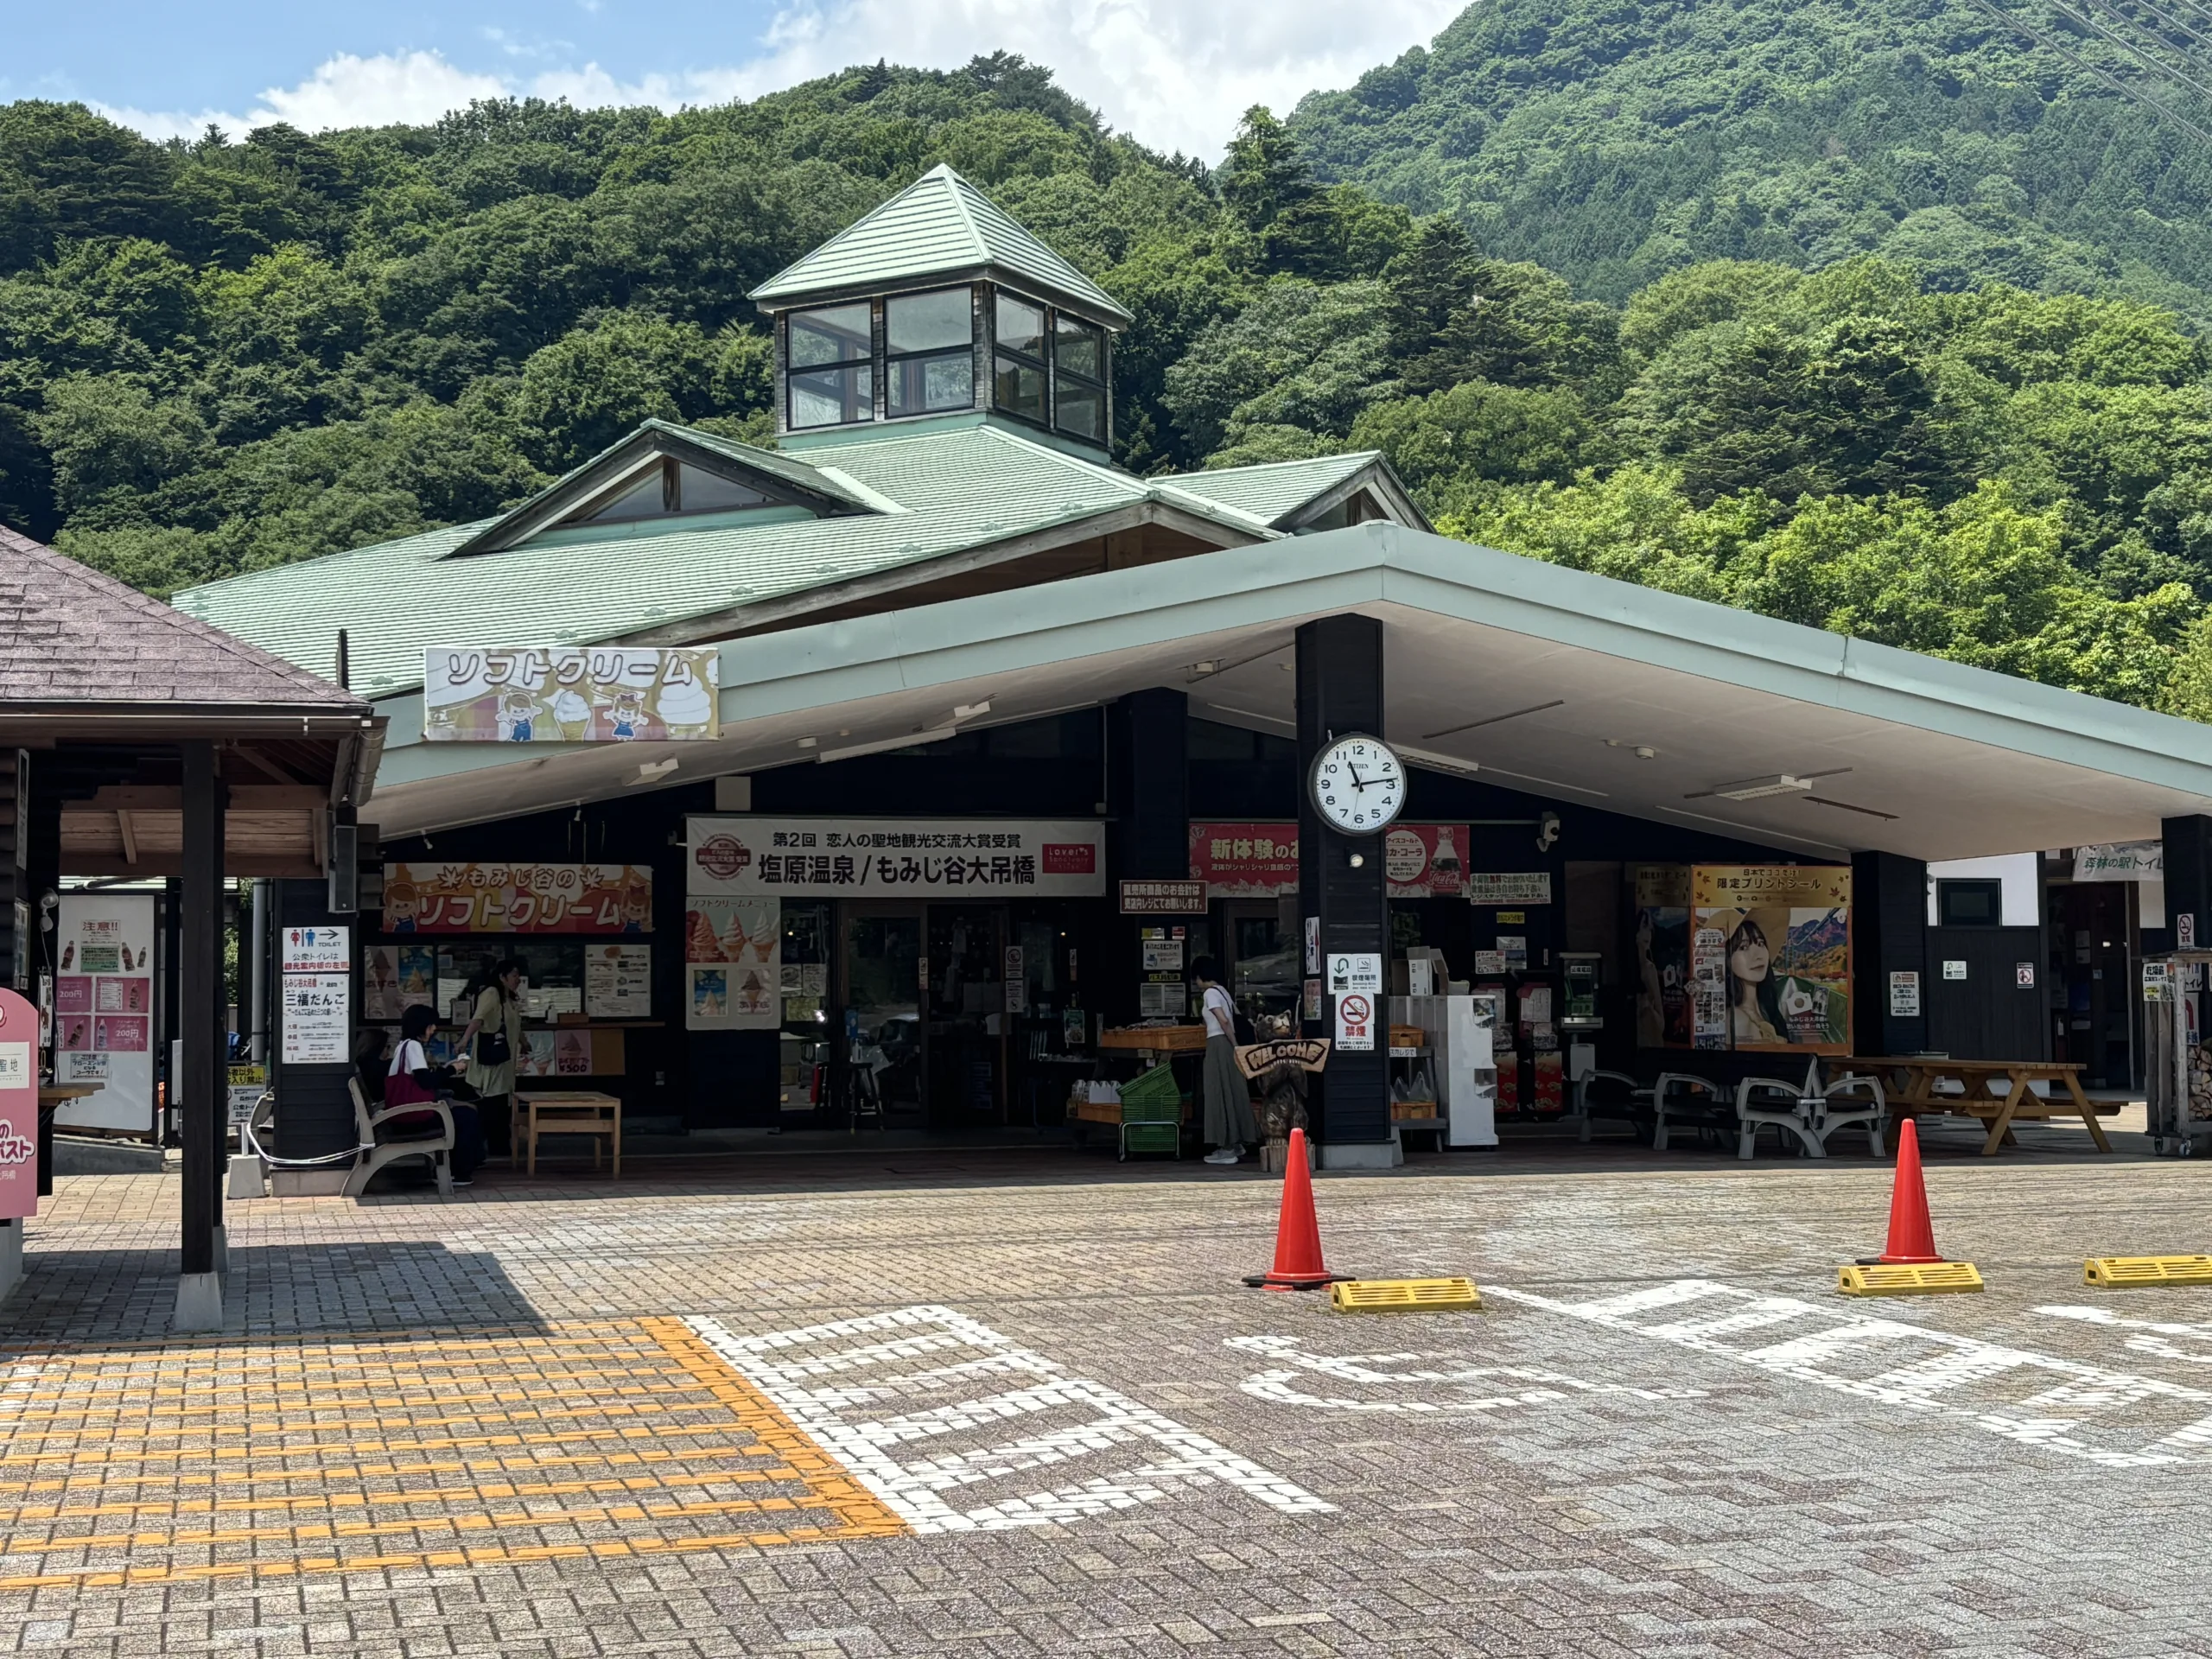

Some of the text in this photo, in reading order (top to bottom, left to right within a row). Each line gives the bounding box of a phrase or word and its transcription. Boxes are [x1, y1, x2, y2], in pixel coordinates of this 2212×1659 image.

[448, 652, 693, 686] ソフトクリーム
[1352, 745, 1365, 755] 12
[1374, 750, 1377, 760] 1
[1336, 751, 1347, 760] 11
[1325, 764, 1338, 774] 10
[1382, 762, 1392, 772] 2
[1320, 779, 1331, 790] 9
[1385, 779, 1395, 790] 3
[1325, 795, 1336, 805] 8
[1382, 796, 1393, 806] 4
[1339, 809, 1349, 818] 7
[1371, 809, 1381, 818] 5
[1354, 814, 1364, 824] 6
[772, 832, 1021, 849] 第2回 恋人の聖地観光交流大賞受賞
[2083, 856, 2163, 870] 森林の駅トイレ
[759, 855, 857, 885] 塩原温泉
[877, 855, 1035, 885] もみじ谷大吊橋
[467, 869, 577, 890] もみじ谷の
[1716, 877, 1821, 890] 限定プリントシール
[418, 893, 622, 927] ソフトクリーム
[82, 921, 118, 931] 注意!!
[292, 952, 340, 962] 公衆トイレは
[60, 990, 82, 999] 200円
[116, 1029, 138, 1038] 200円
[1345, 1026, 1366, 1037] 禁煙
[1248, 1042, 1325, 1070] WELCOME
